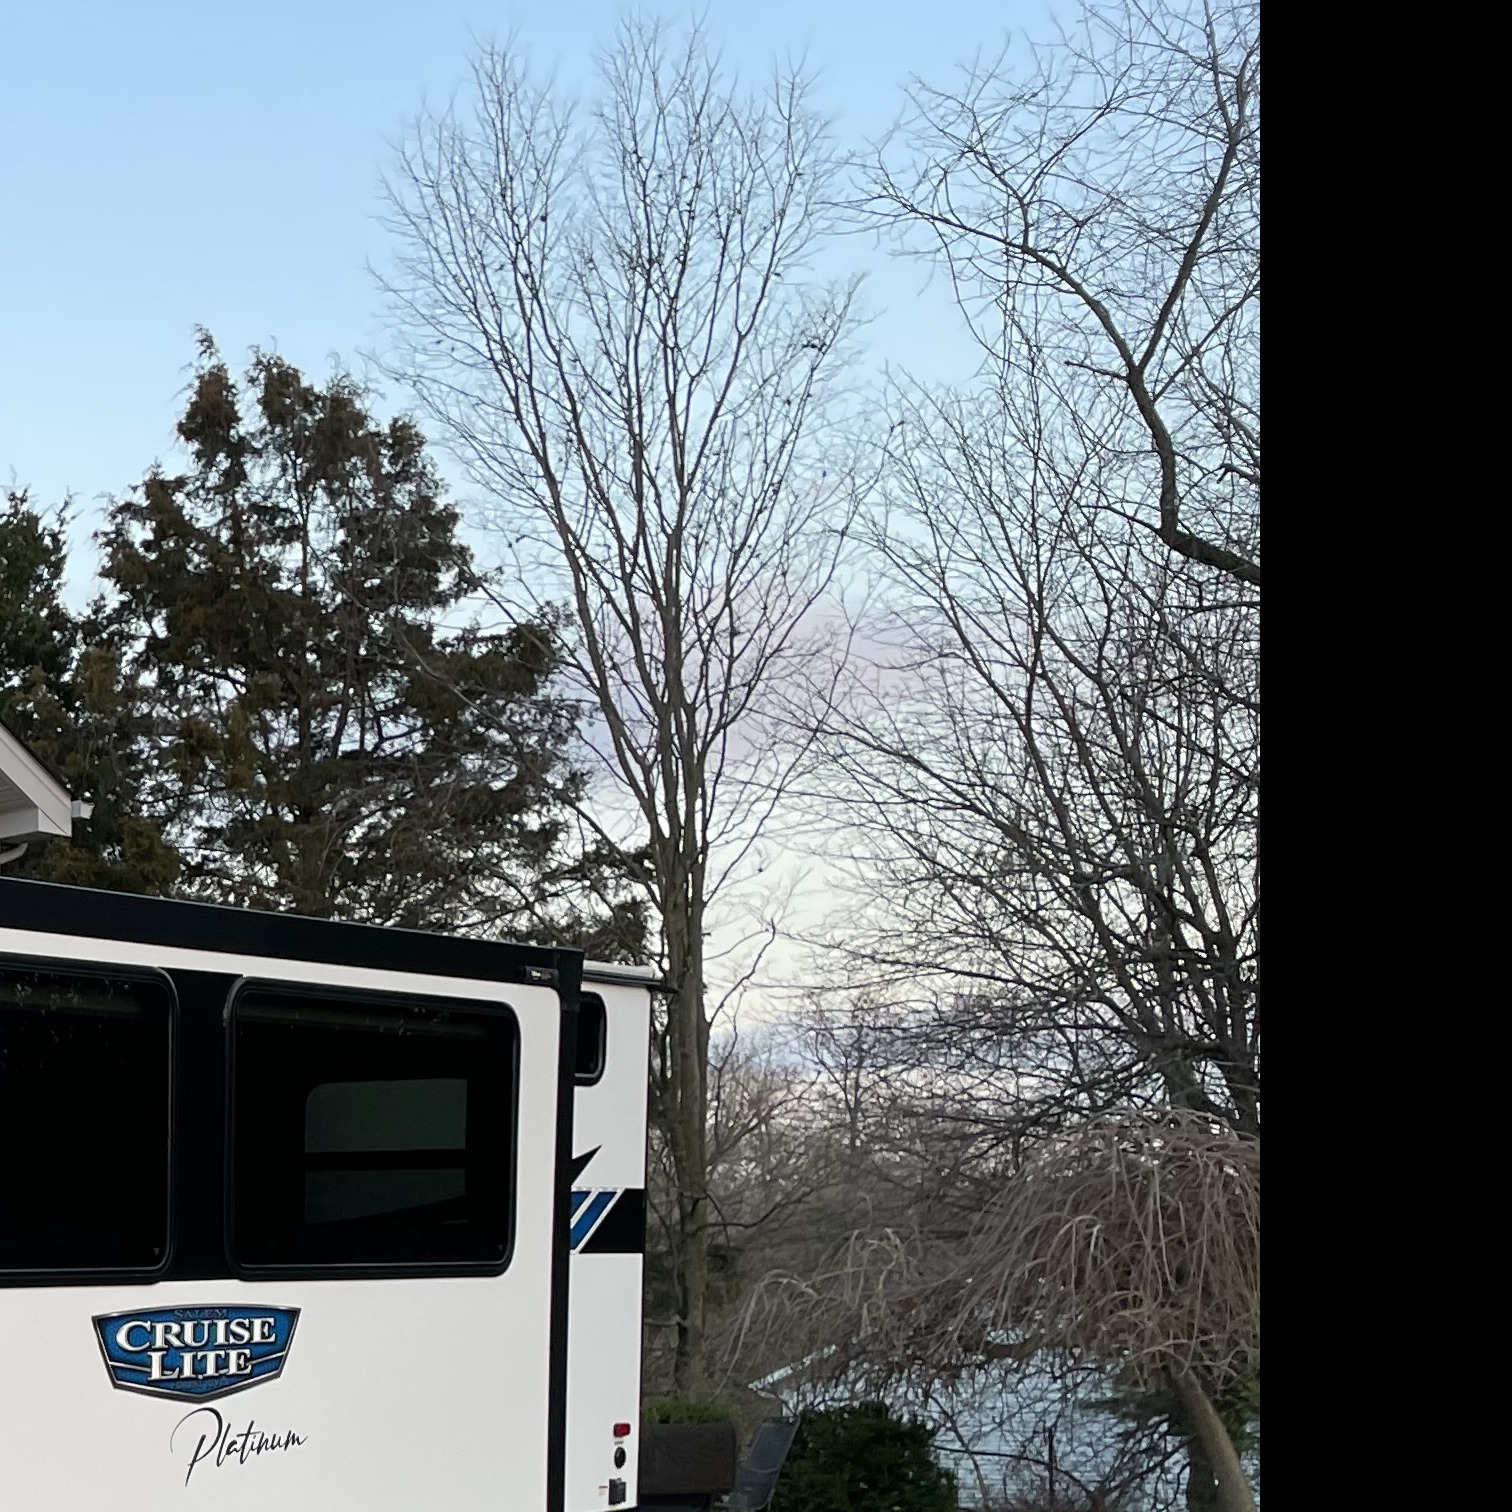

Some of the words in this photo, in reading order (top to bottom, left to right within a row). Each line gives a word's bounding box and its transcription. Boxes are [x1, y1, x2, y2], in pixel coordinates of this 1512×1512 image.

[174, 1308, 228, 1320] SALEM
[115, 1317, 276, 1351] CRUISE
[147, 1348, 252, 1381] LITE
[170, 1407, 308, 1487] Platinum
